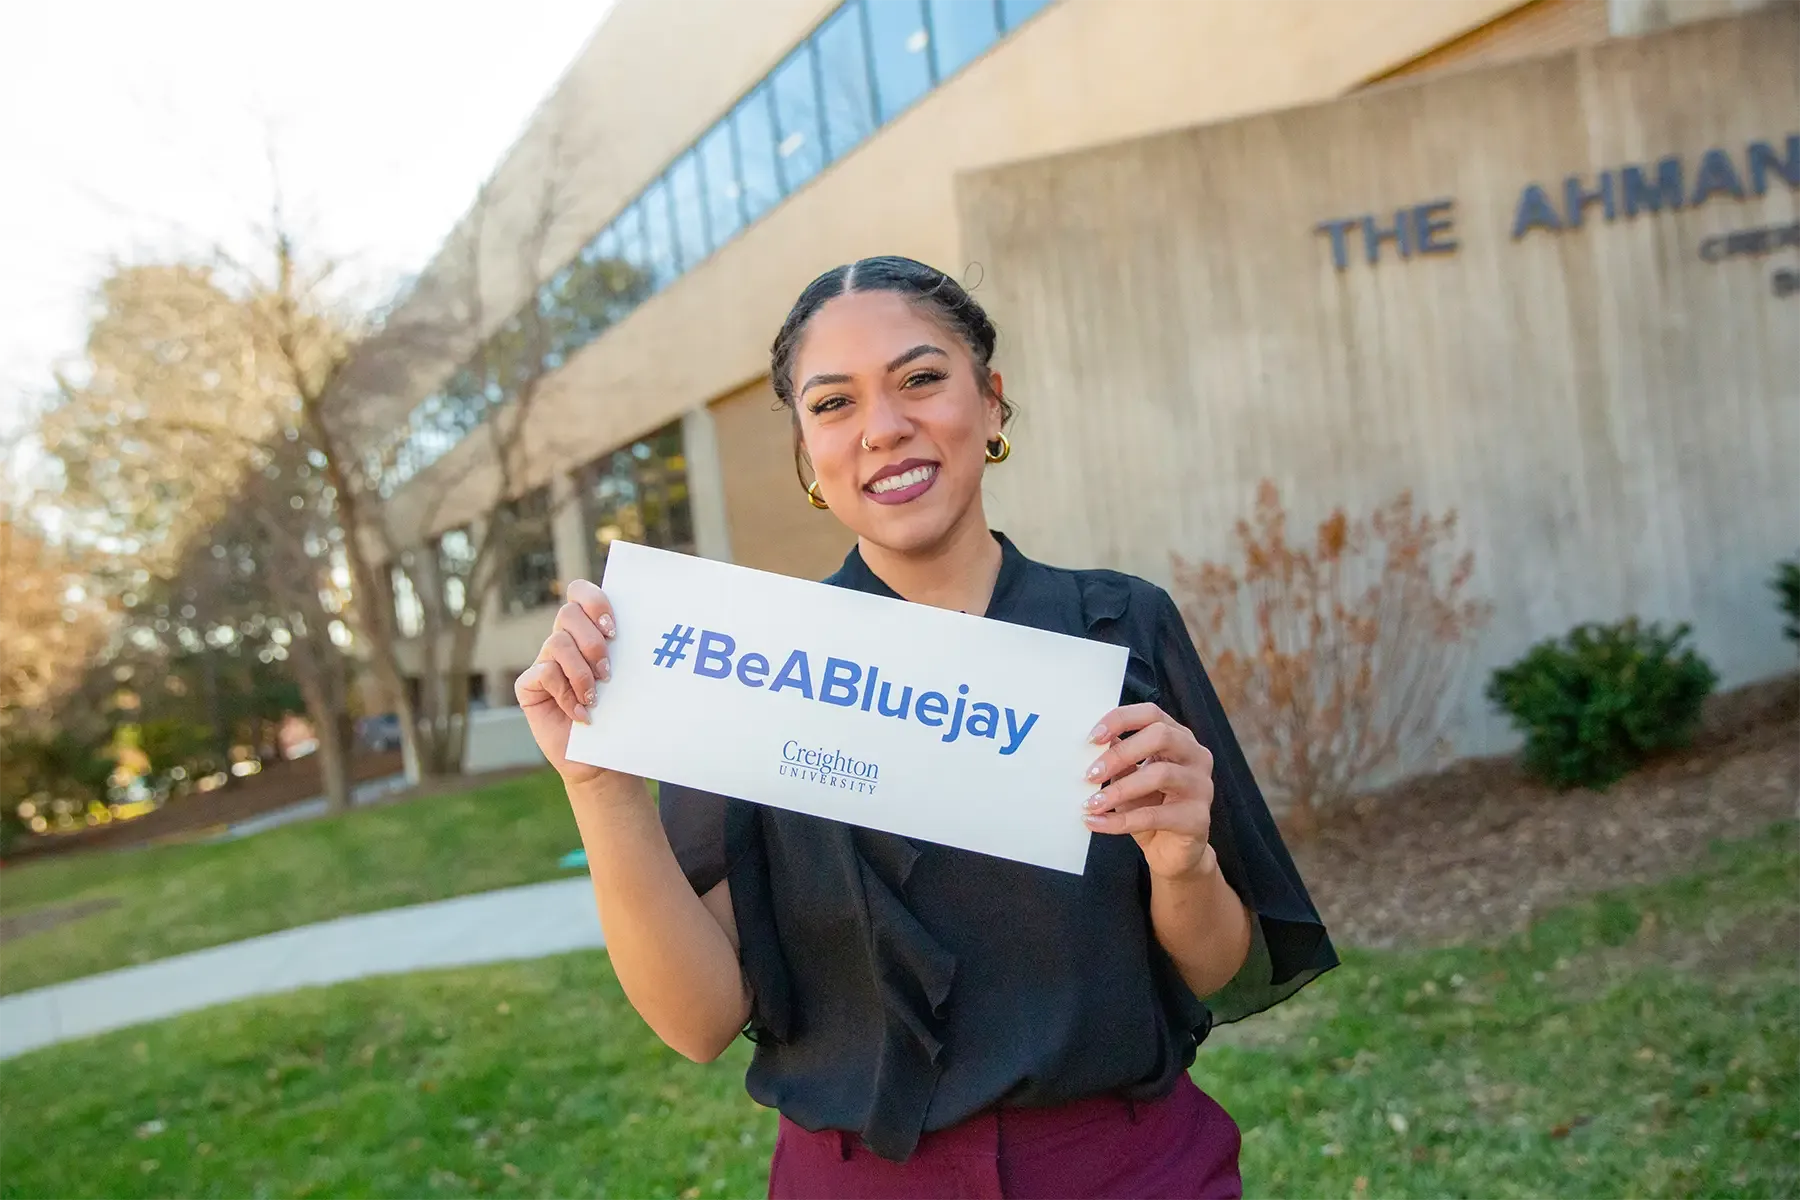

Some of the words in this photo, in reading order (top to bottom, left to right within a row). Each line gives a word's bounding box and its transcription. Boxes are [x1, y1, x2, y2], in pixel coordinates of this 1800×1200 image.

[1313, 198, 1459, 271] THE
[652, 623, 1040, 755] #BeABluejay
[779, 764, 876, 795] UNIVERSITY
[782, 739, 879, 780] Creighton
